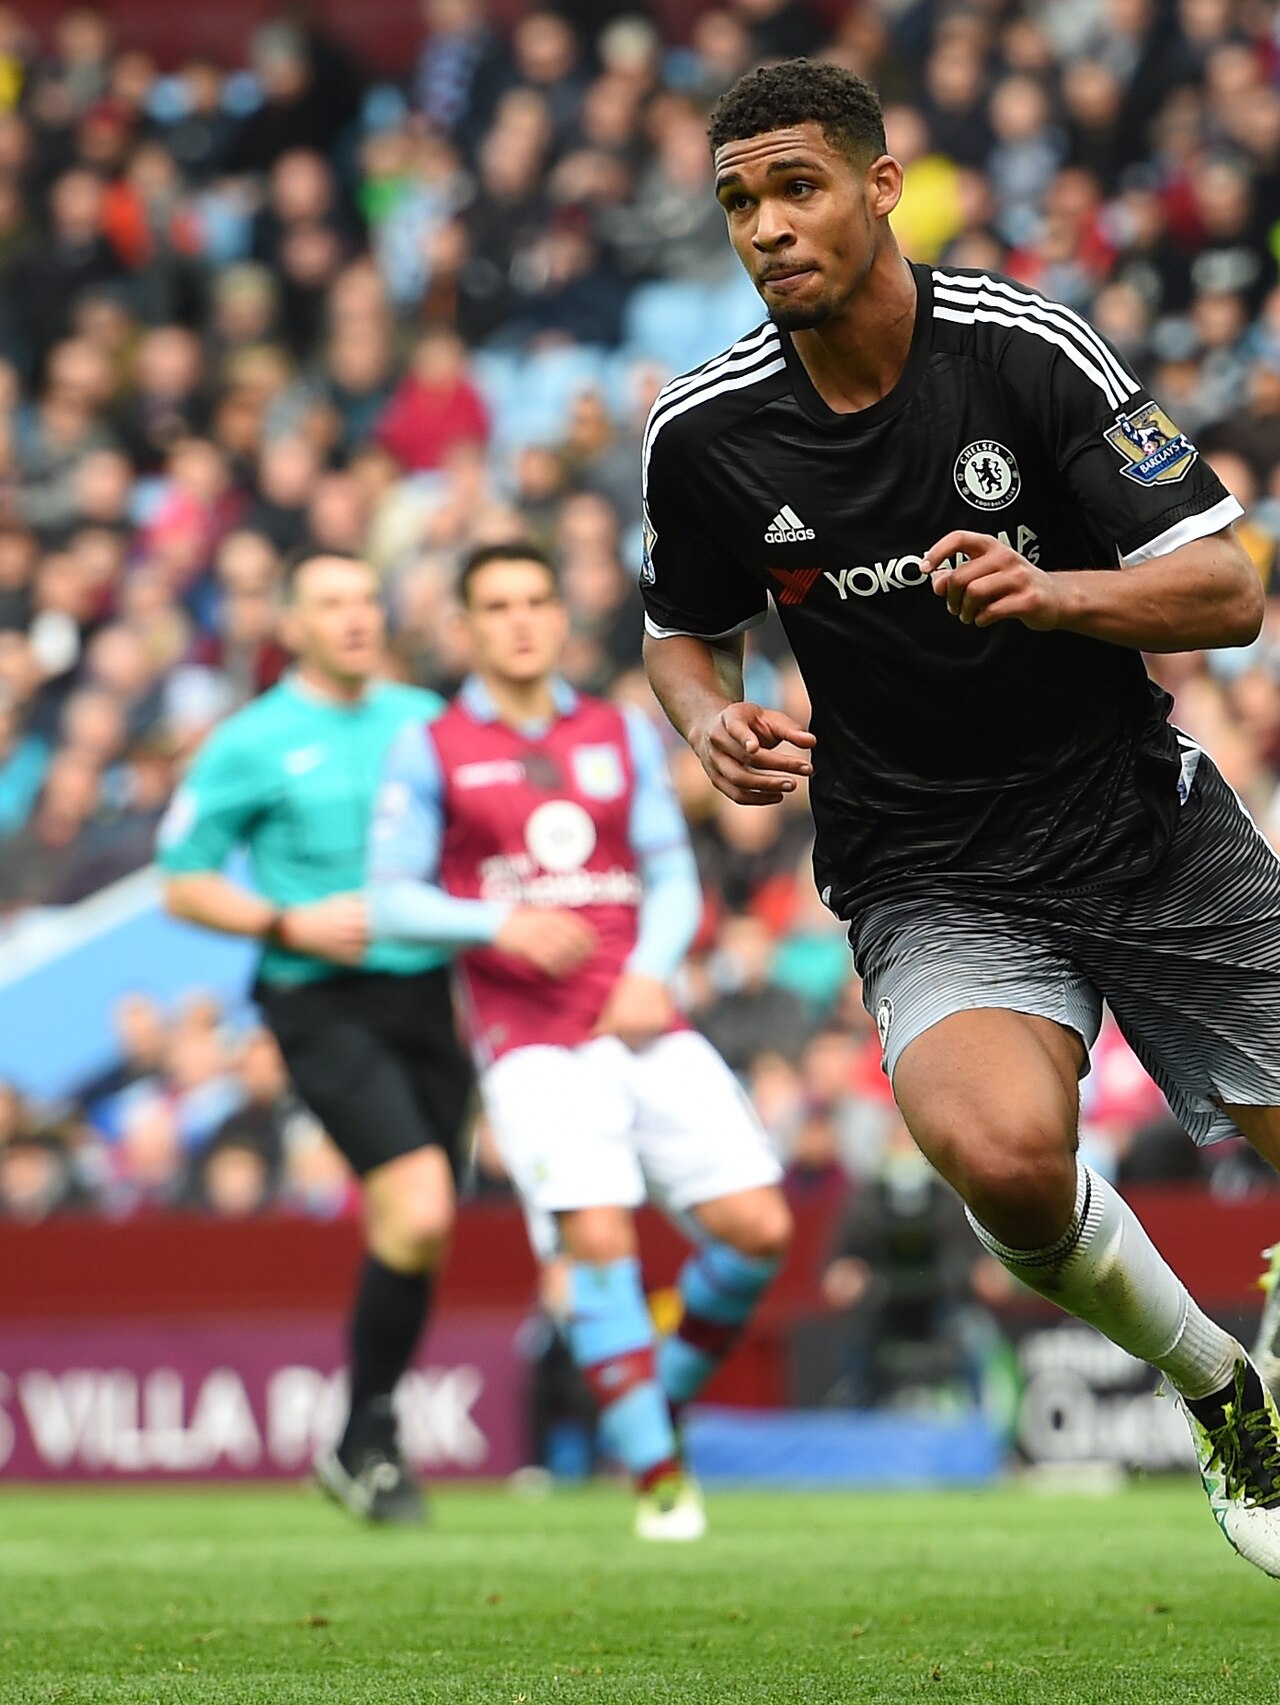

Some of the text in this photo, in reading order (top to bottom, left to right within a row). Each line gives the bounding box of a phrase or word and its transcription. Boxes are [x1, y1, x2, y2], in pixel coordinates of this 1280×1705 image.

[960, 443, 1000, 465] CHELSEA
[1139, 441, 1180, 474] BARCLAYS
[764, 528, 816, 543] adidas
[17, 1366, 264, 1472] VILLA
